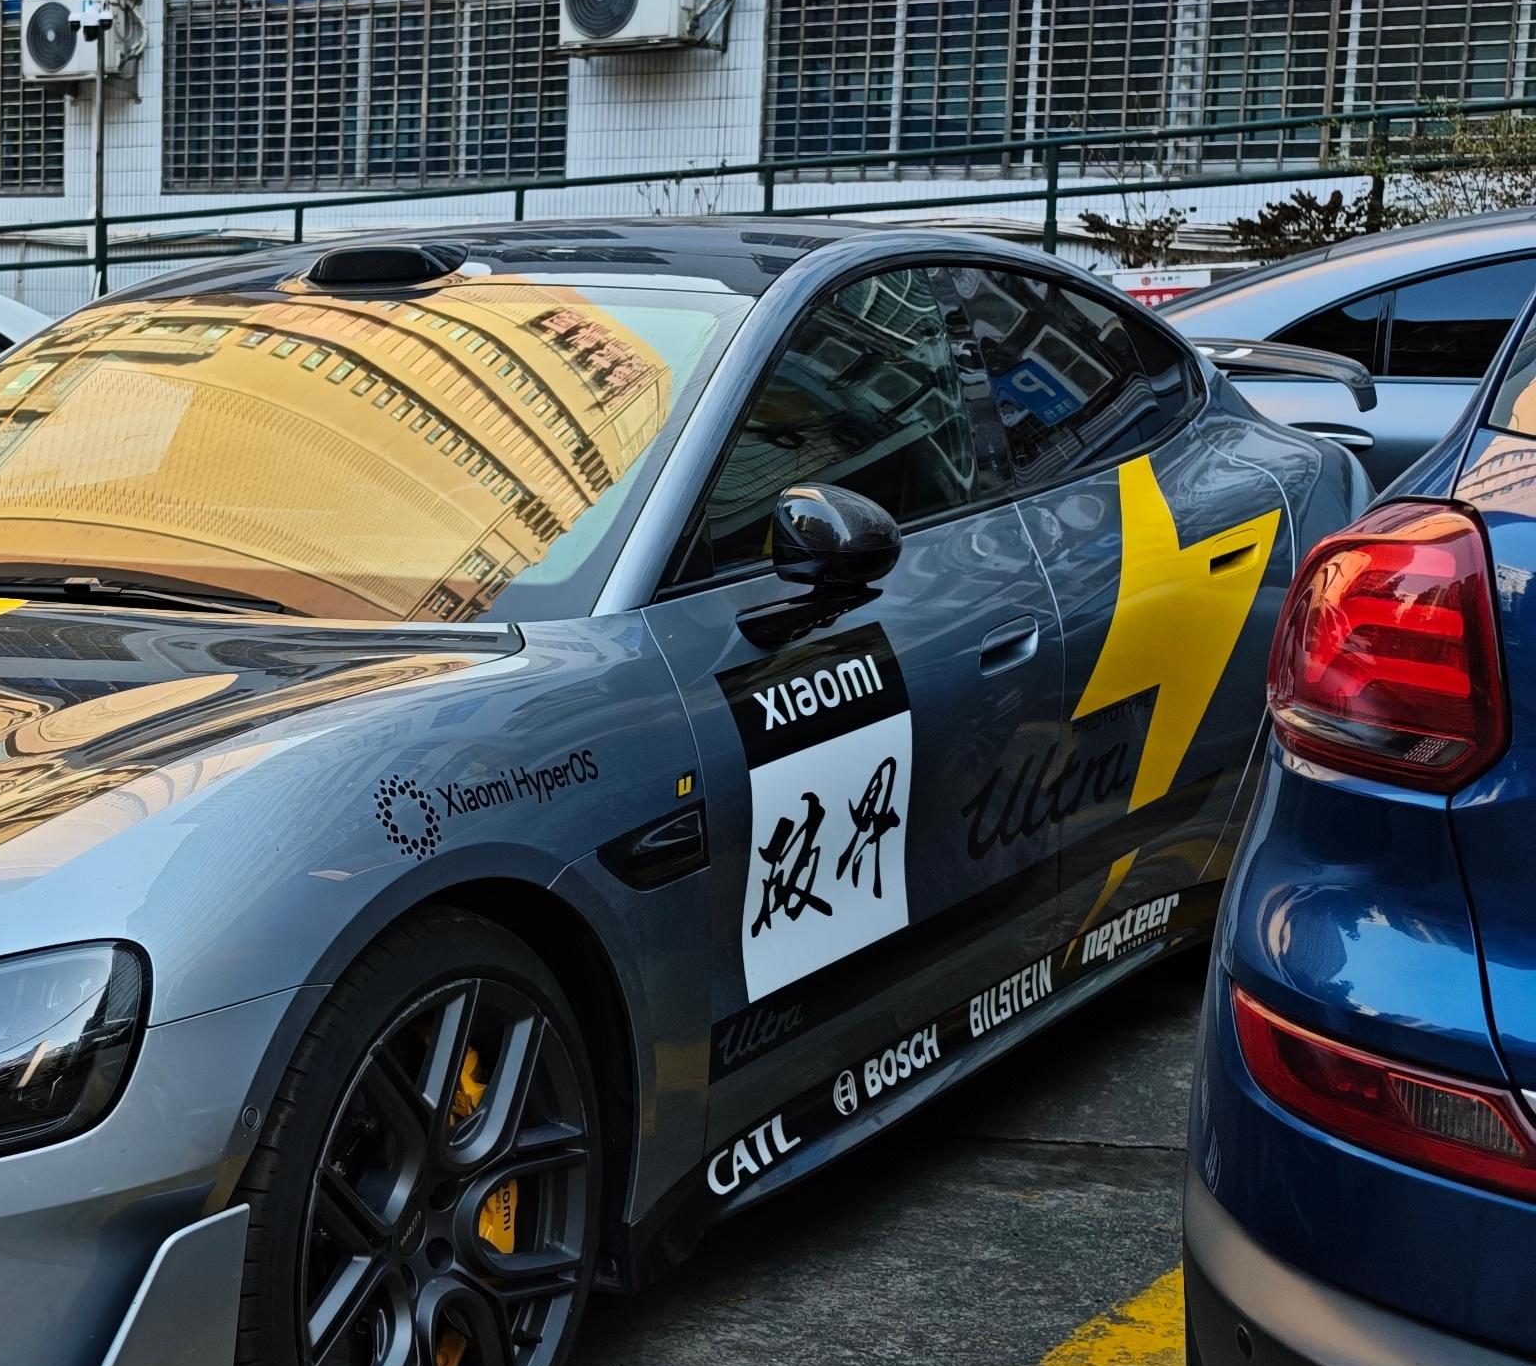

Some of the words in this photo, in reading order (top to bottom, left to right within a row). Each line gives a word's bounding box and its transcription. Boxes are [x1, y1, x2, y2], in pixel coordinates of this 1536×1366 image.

[1072, 692, 1152, 738] PROTOTYPE
[436, 771, 513, 818] Xiaomi
[513, 749, 599, 804] HyperOS
[961, 742, 1132, 862] Ultra
[1081, 892, 1180, 966] nexteer
[717, 1003, 805, 1066] Ultra
[969, 955, 1054, 1039] BILSTEIN
[864, 1023, 941, 1100] BOSCH
[706, 1113, 802, 1196] CATL
